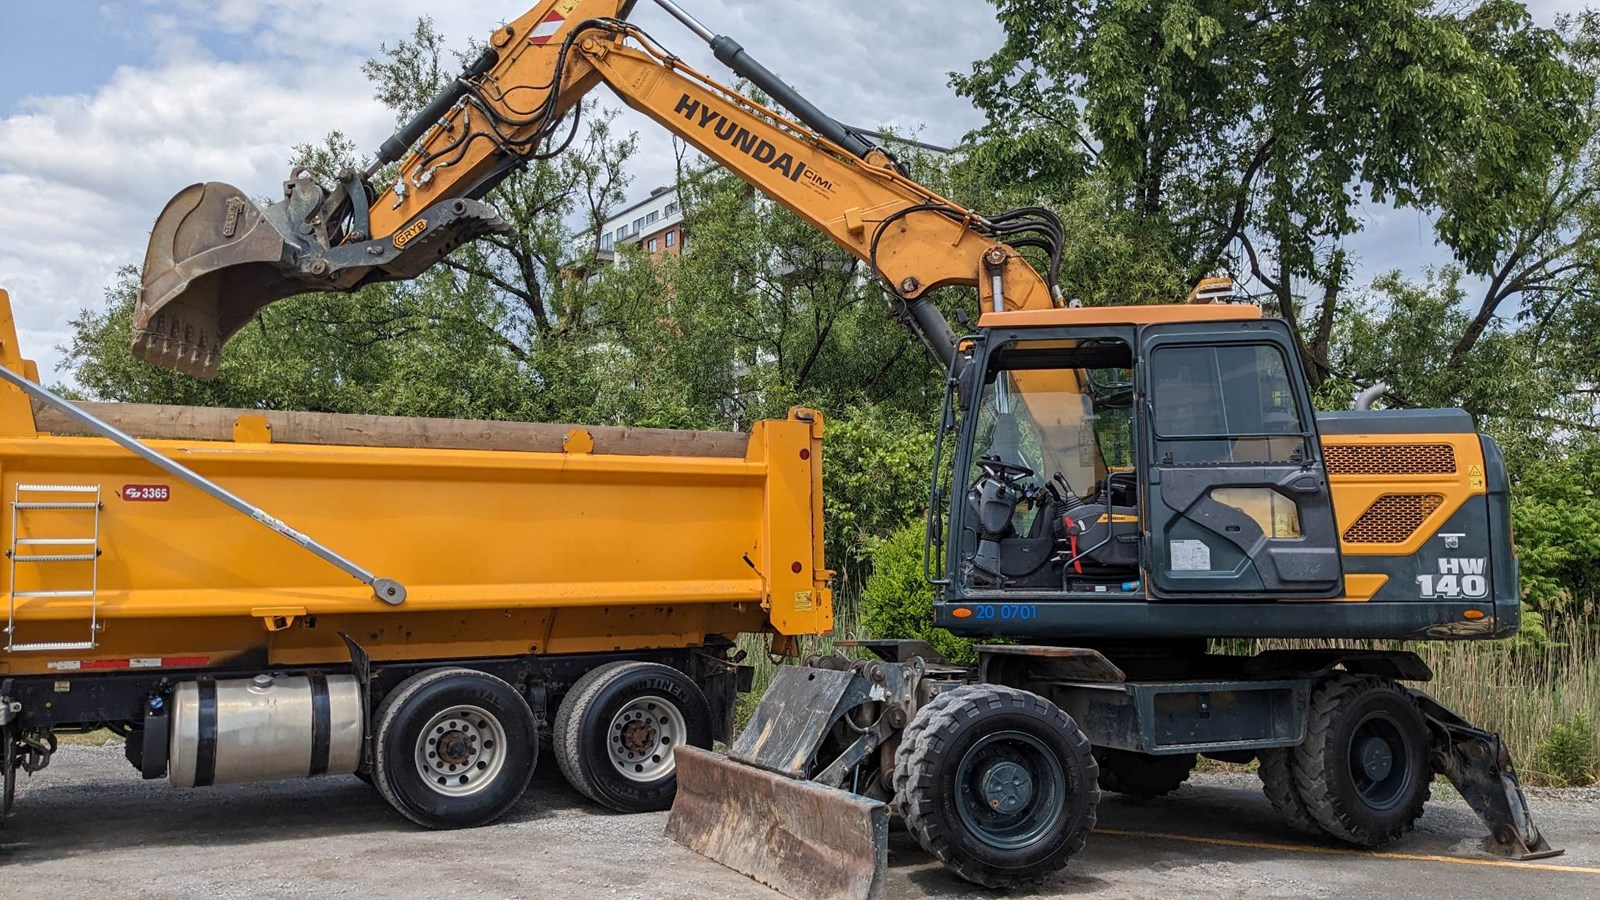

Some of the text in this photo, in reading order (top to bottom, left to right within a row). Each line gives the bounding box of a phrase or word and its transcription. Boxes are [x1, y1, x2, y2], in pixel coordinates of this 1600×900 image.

[673, 93, 806, 183] HYUNDAI
[803, 169, 832, 190] CIMI
[397, 221, 425, 244] GRYB
[142, 488, 168, 499] 3365
[1437, 557, 1485, 575] HW
[1416, 574, 1487, 597] 140
[975, 604, 1036, 619] 20 0701
